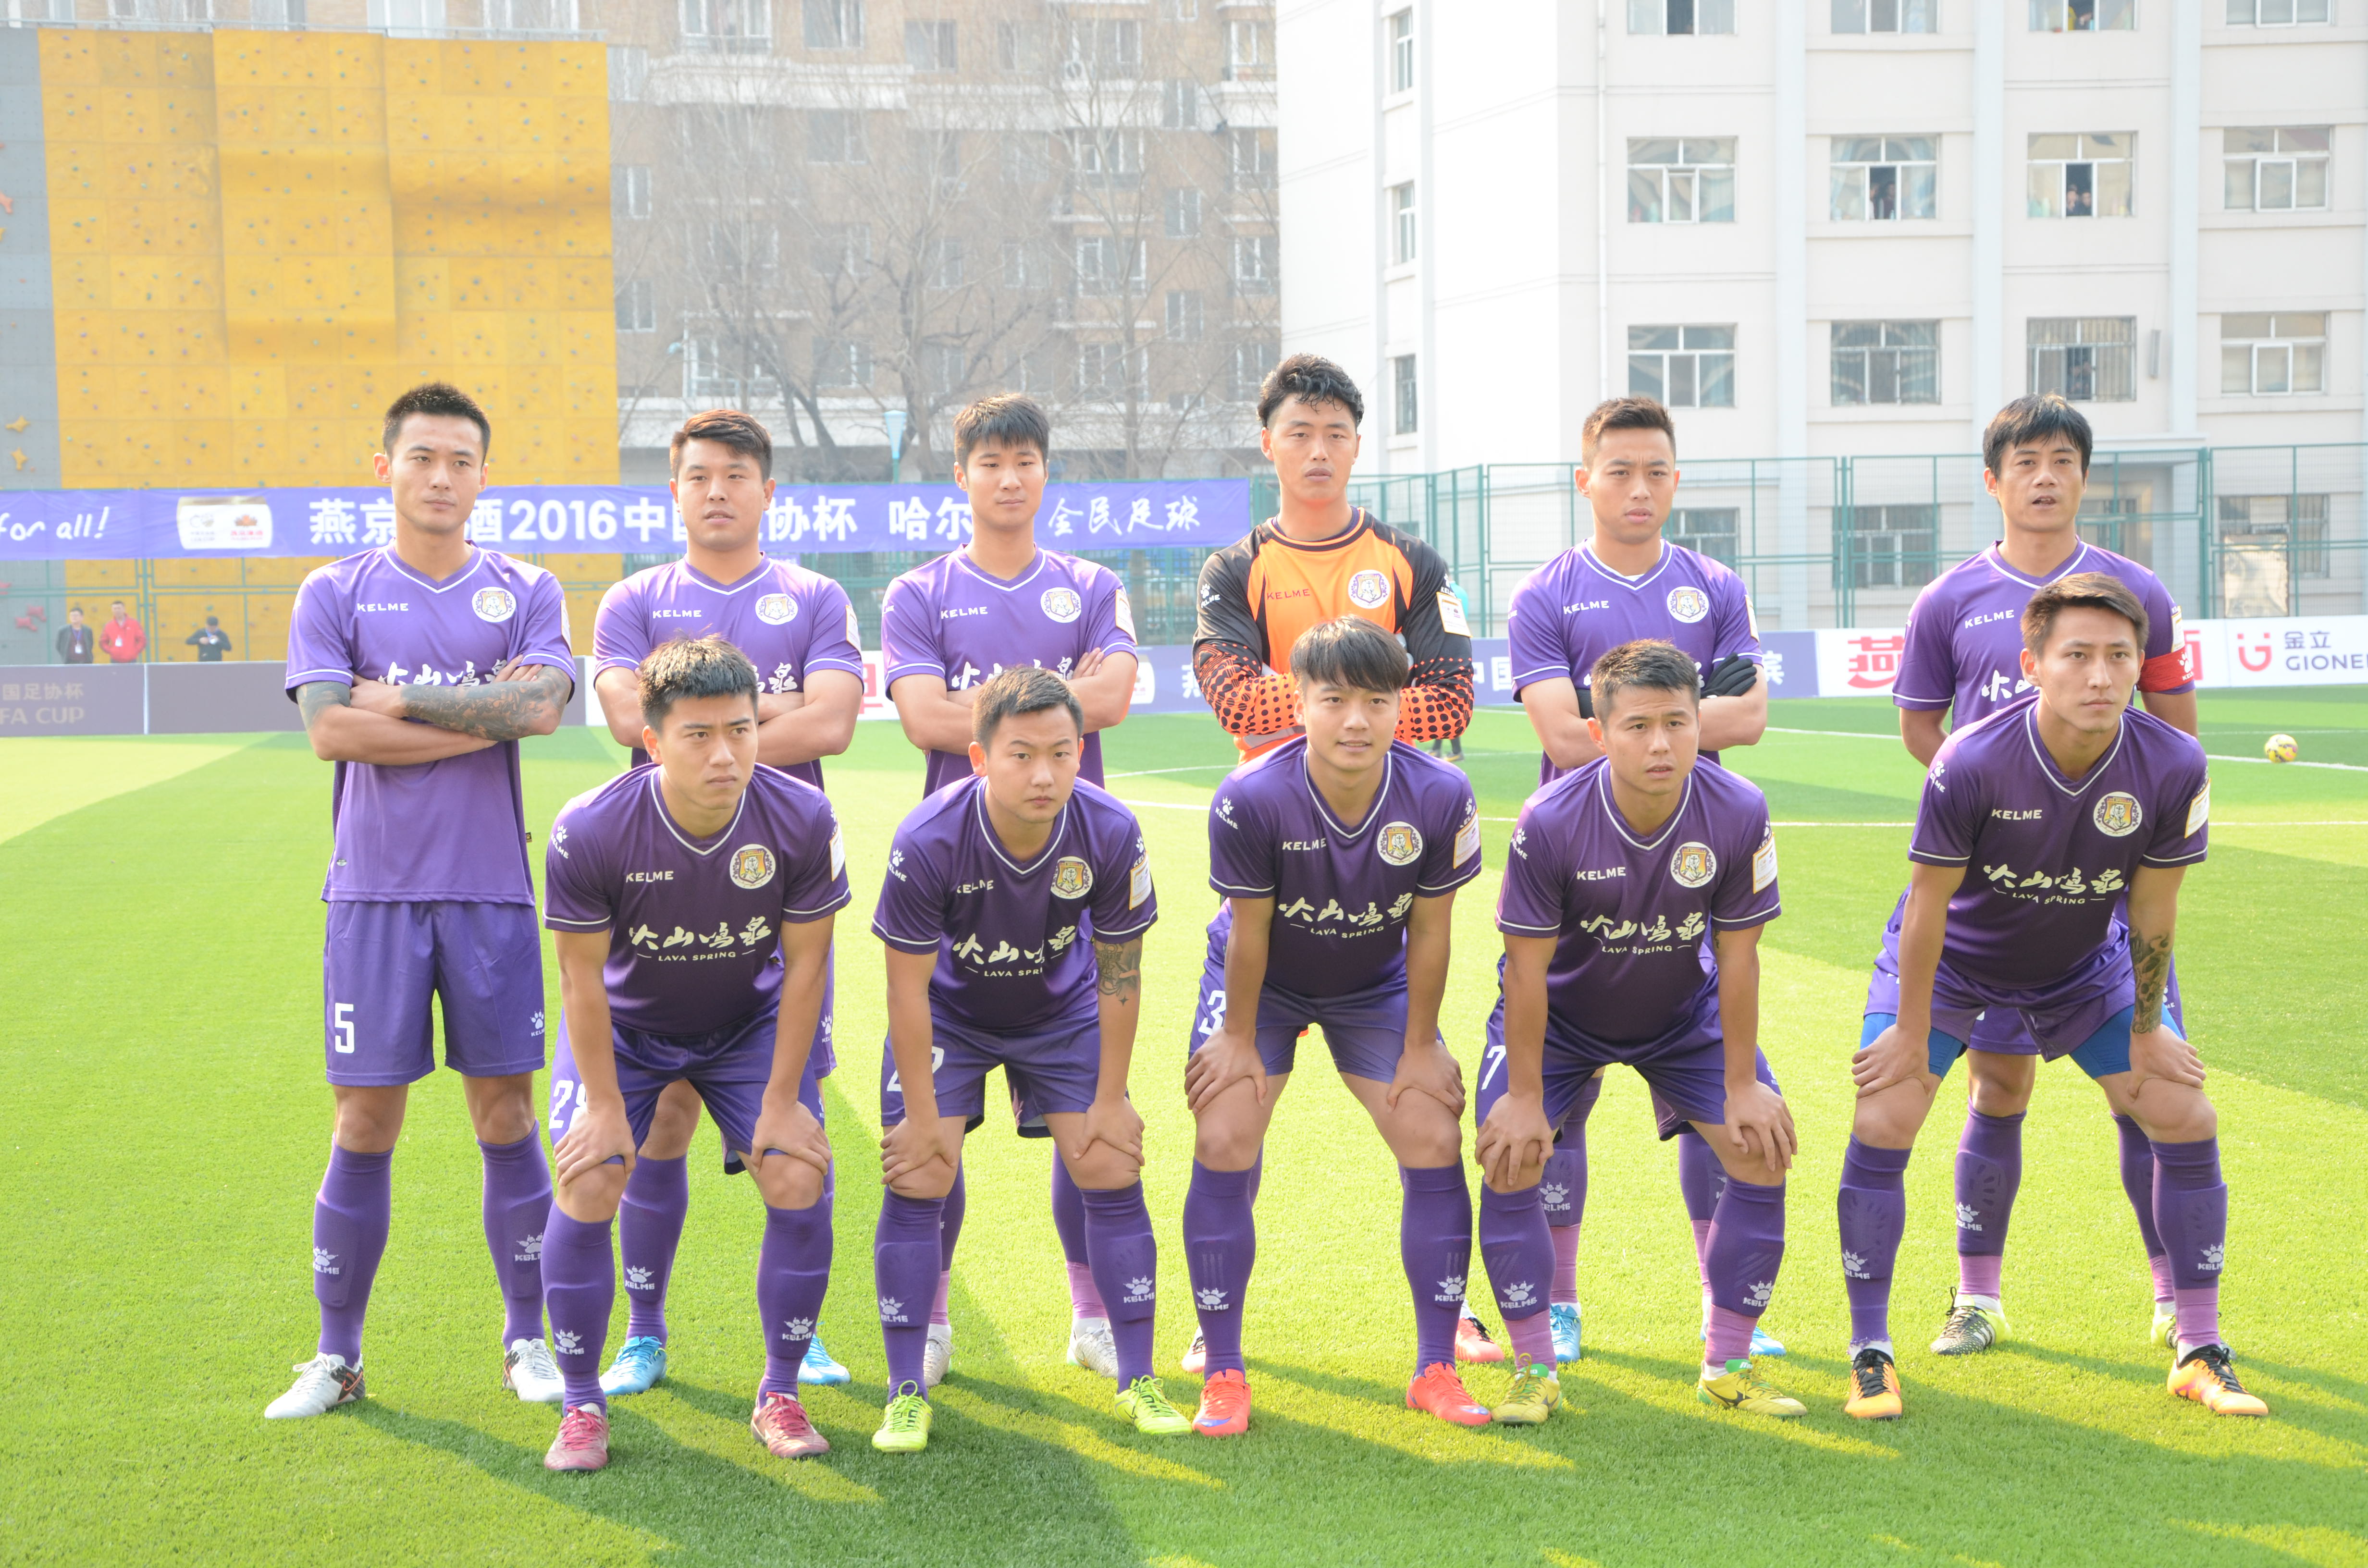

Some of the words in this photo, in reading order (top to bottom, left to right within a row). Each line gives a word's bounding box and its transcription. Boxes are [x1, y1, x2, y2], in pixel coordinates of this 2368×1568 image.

[56, 506, 110, 540] all!
[1048, 495, 1201, 537] 全民足球
[1267, 588, 1311, 600] KELME
[357, 602, 409, 612] KELME
[652, 609, 702, 619] KELME
[940, 606, 988, 619] KELME
[1563, 600, 1610, 615] KELME
[1964, 609, 2015, 629] KELME
[2283, 630, 2331, 649] 金立
[2285, 653, 2368, 671] GIONE
[35, 706, 85, 724] CUP
[1215, 806, 1238, 830] KELME
[1991, 808, 2043, 821] KELME
[1282, 837, 1327, 851] KELME
[626, 870, 674, 883] KELME
[1577, 866, 1626, 881] KELME
[2012, 892, 2039, 903] LAVA
[2045, 895, 2086, 905] SPRING
[1342, 925, 1384, 939] SPRING
[692, 951, 737, 962] SPRING
[1632, 944, 1673, 956] SPRING
[334, 1003, 355, 1054] 5
[1480, 1045, 1506, 1091] 7
[625, 1279, 654, 1290] KELME
[1500, 1297, 1538, 1310] KELME
[555, 1344, 584, 1355] KELME
